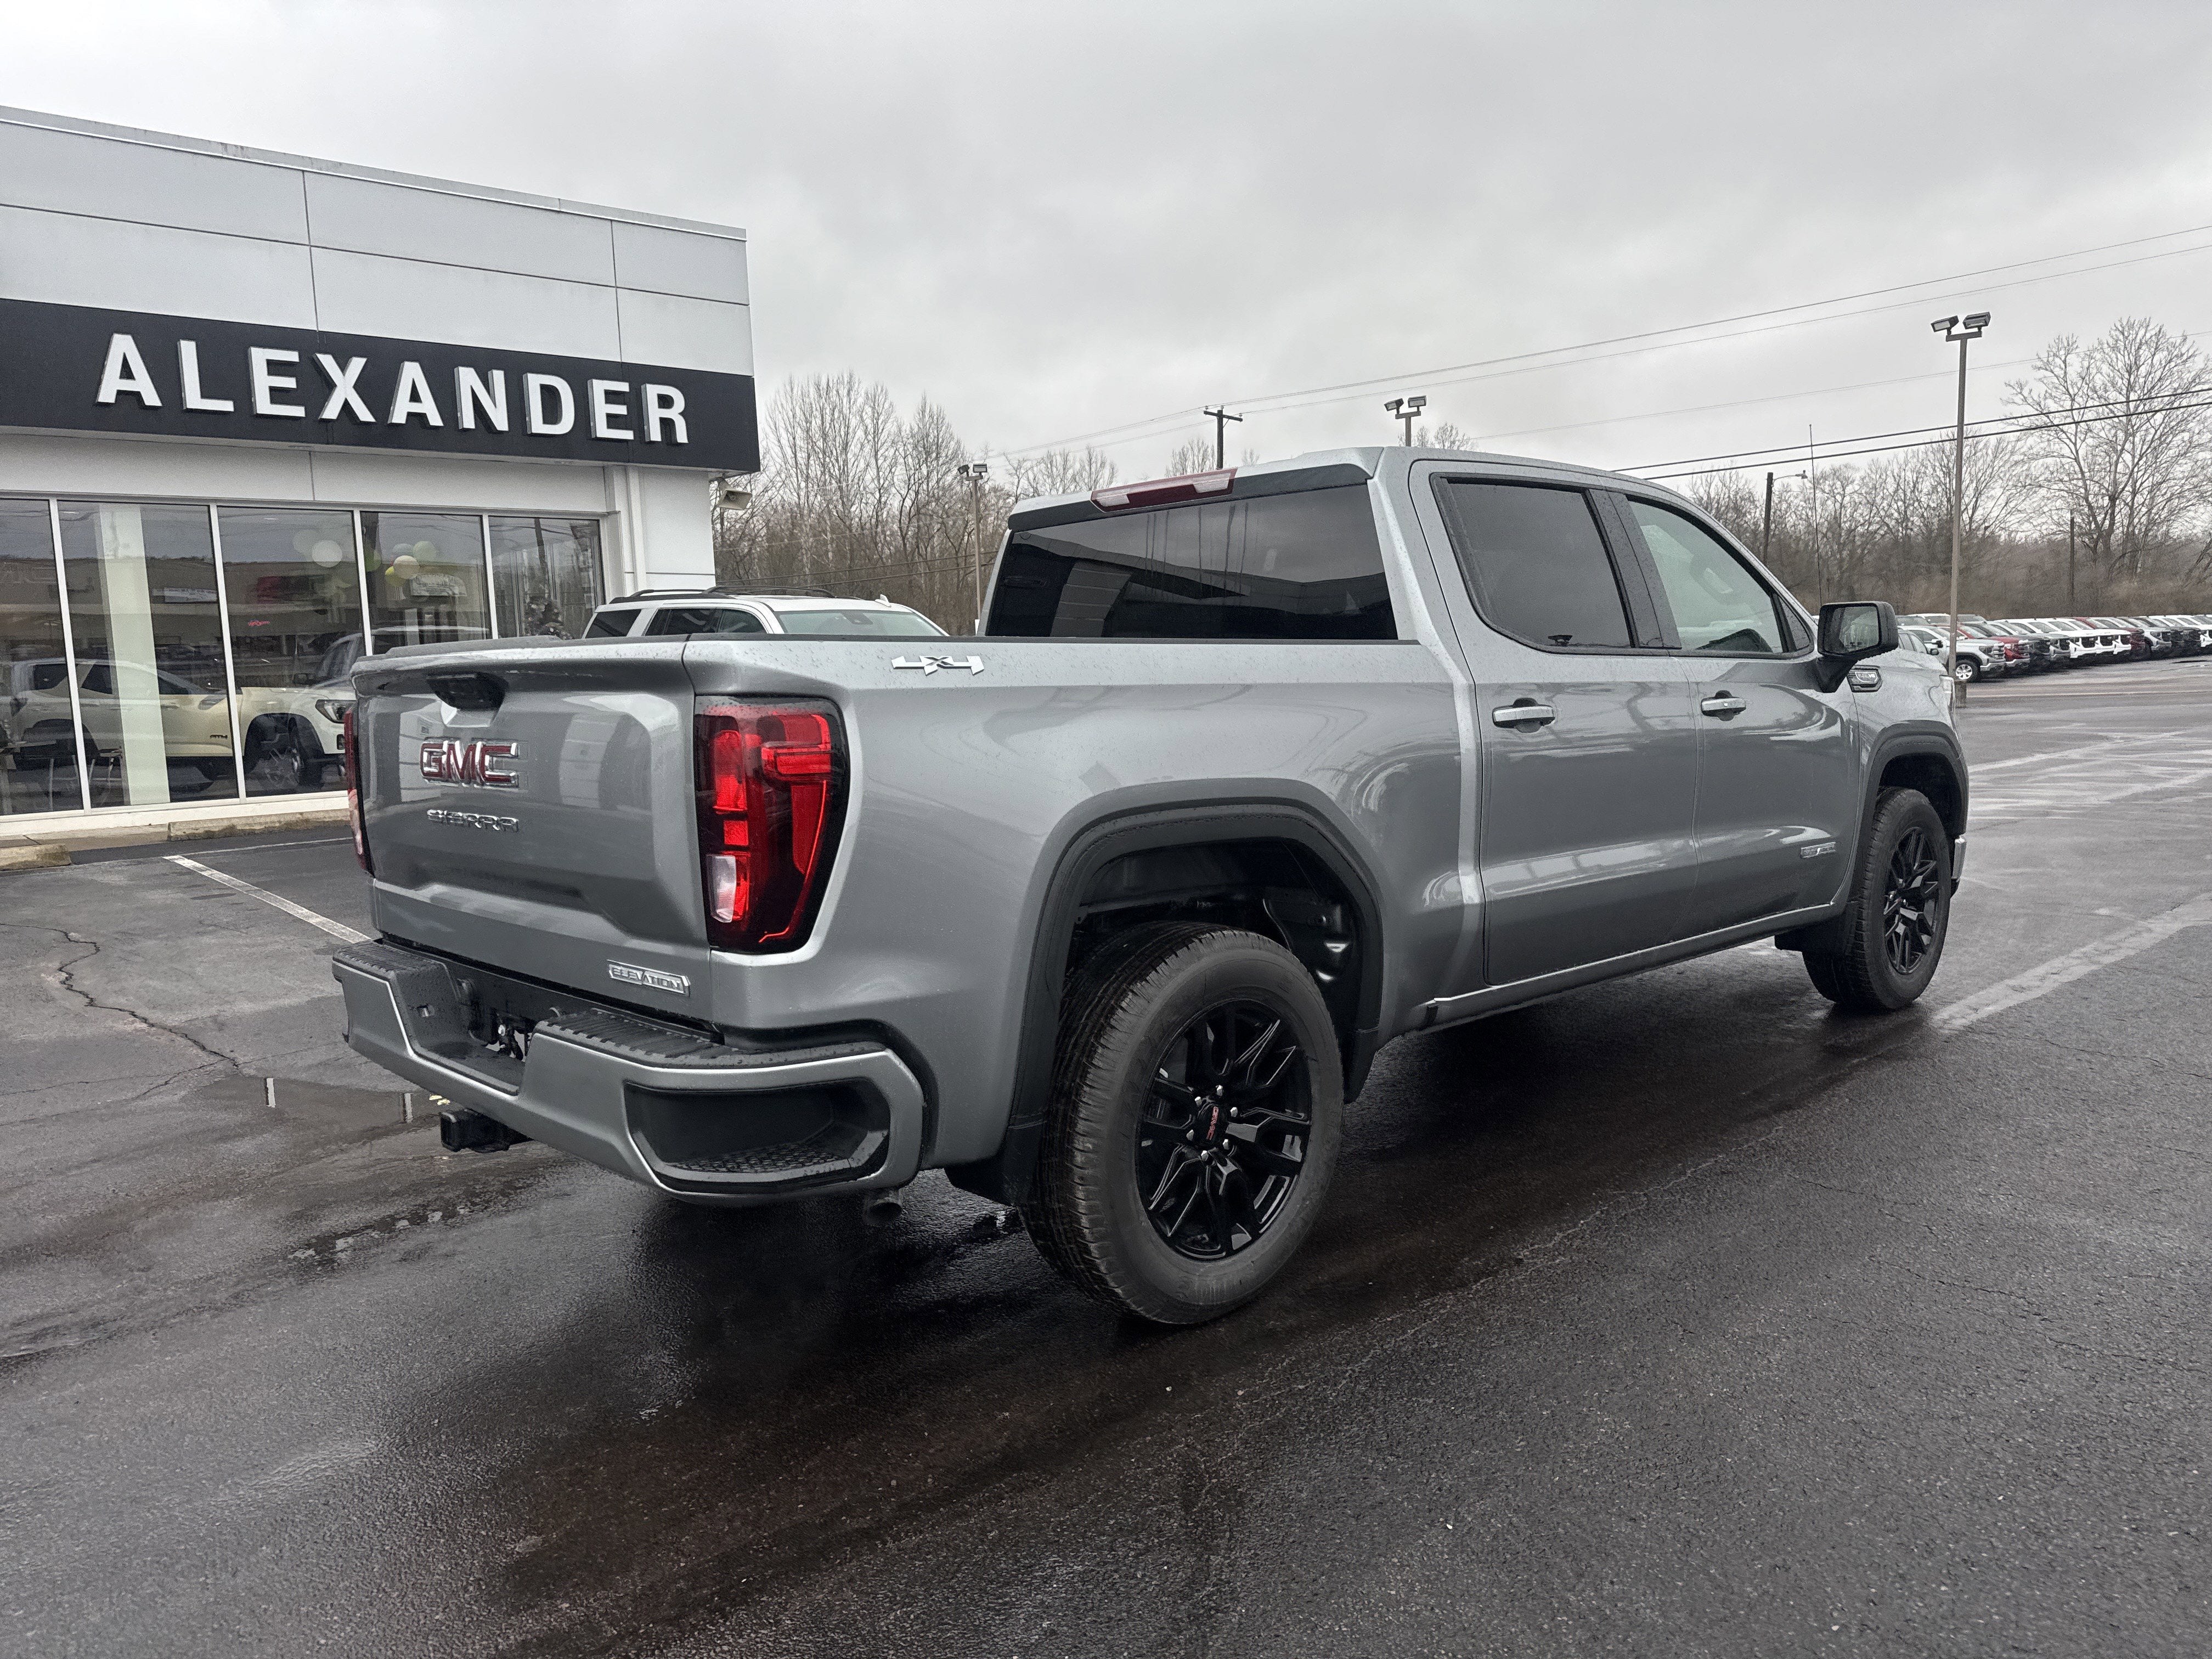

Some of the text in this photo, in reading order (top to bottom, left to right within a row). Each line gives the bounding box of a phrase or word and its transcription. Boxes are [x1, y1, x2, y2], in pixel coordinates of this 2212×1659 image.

[96, 332, 689, 444] ALEXANDER
[420, 740, 520, 788] GMC
[610, 964, 684, 992] ELEVATION
[1206, 1106, 1219, 1141] GMC
